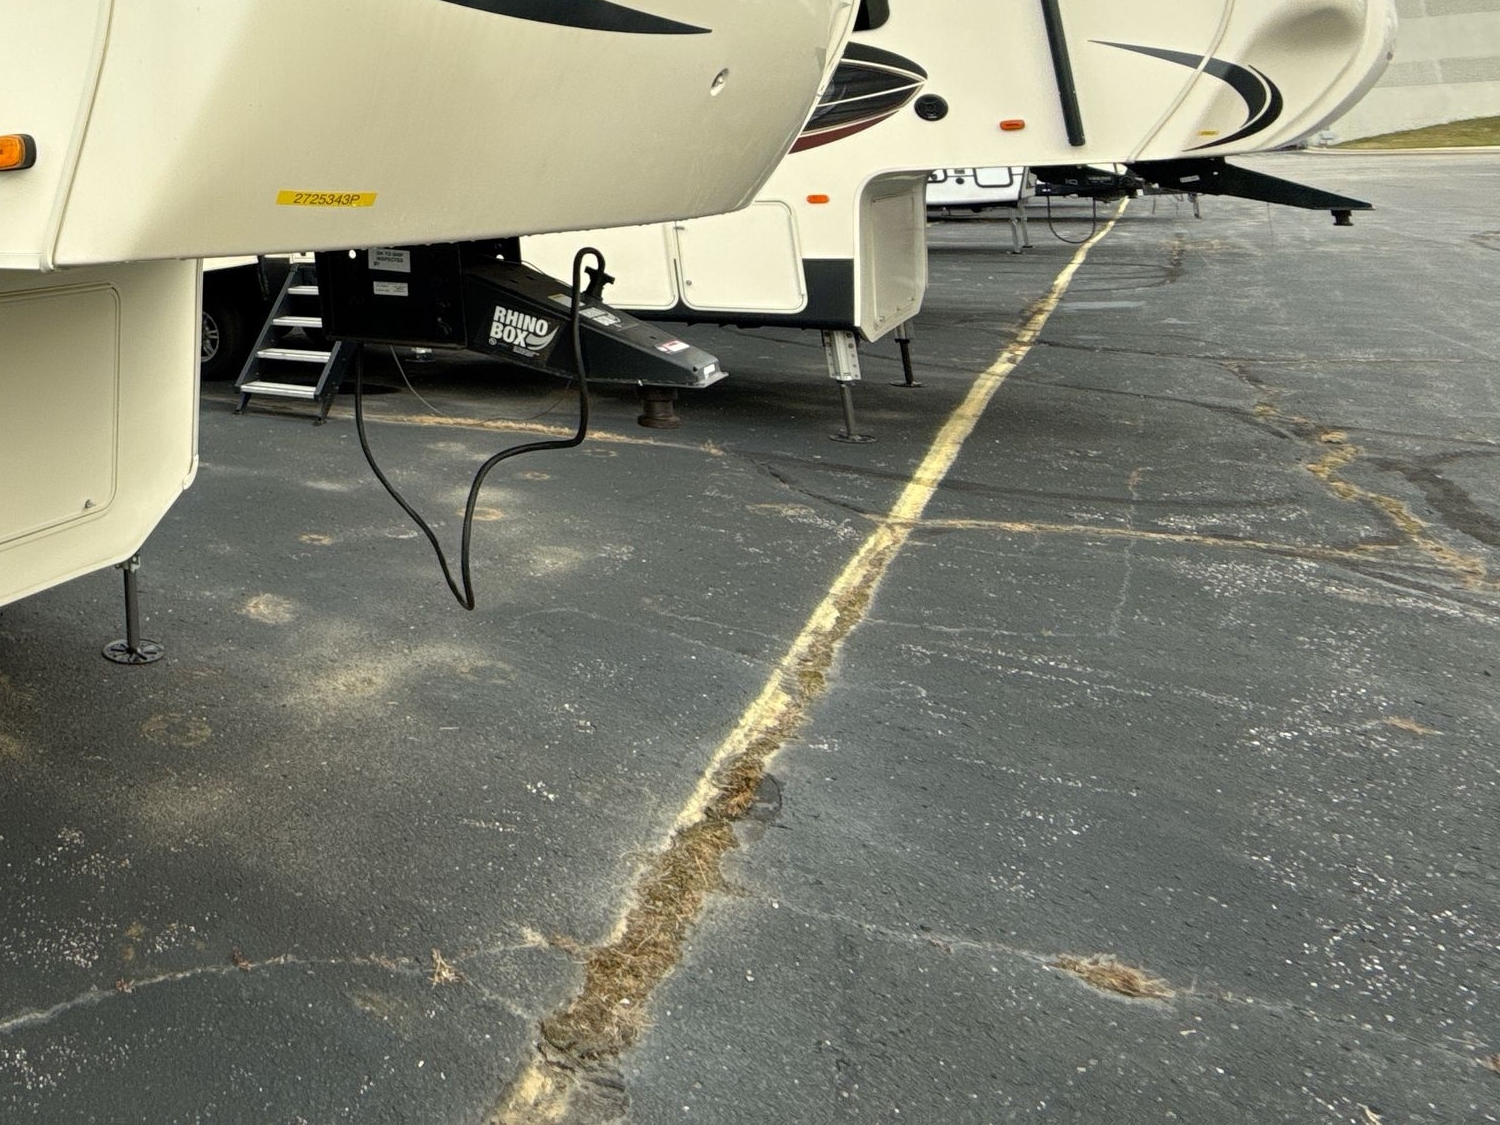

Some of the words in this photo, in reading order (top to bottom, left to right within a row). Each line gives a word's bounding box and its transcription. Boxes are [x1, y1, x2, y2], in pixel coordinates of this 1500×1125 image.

[293, 193, 361, 205] 2725343P
[493, 305, 549, 336] RHINO
[490, 321, 527, 348] BOX
